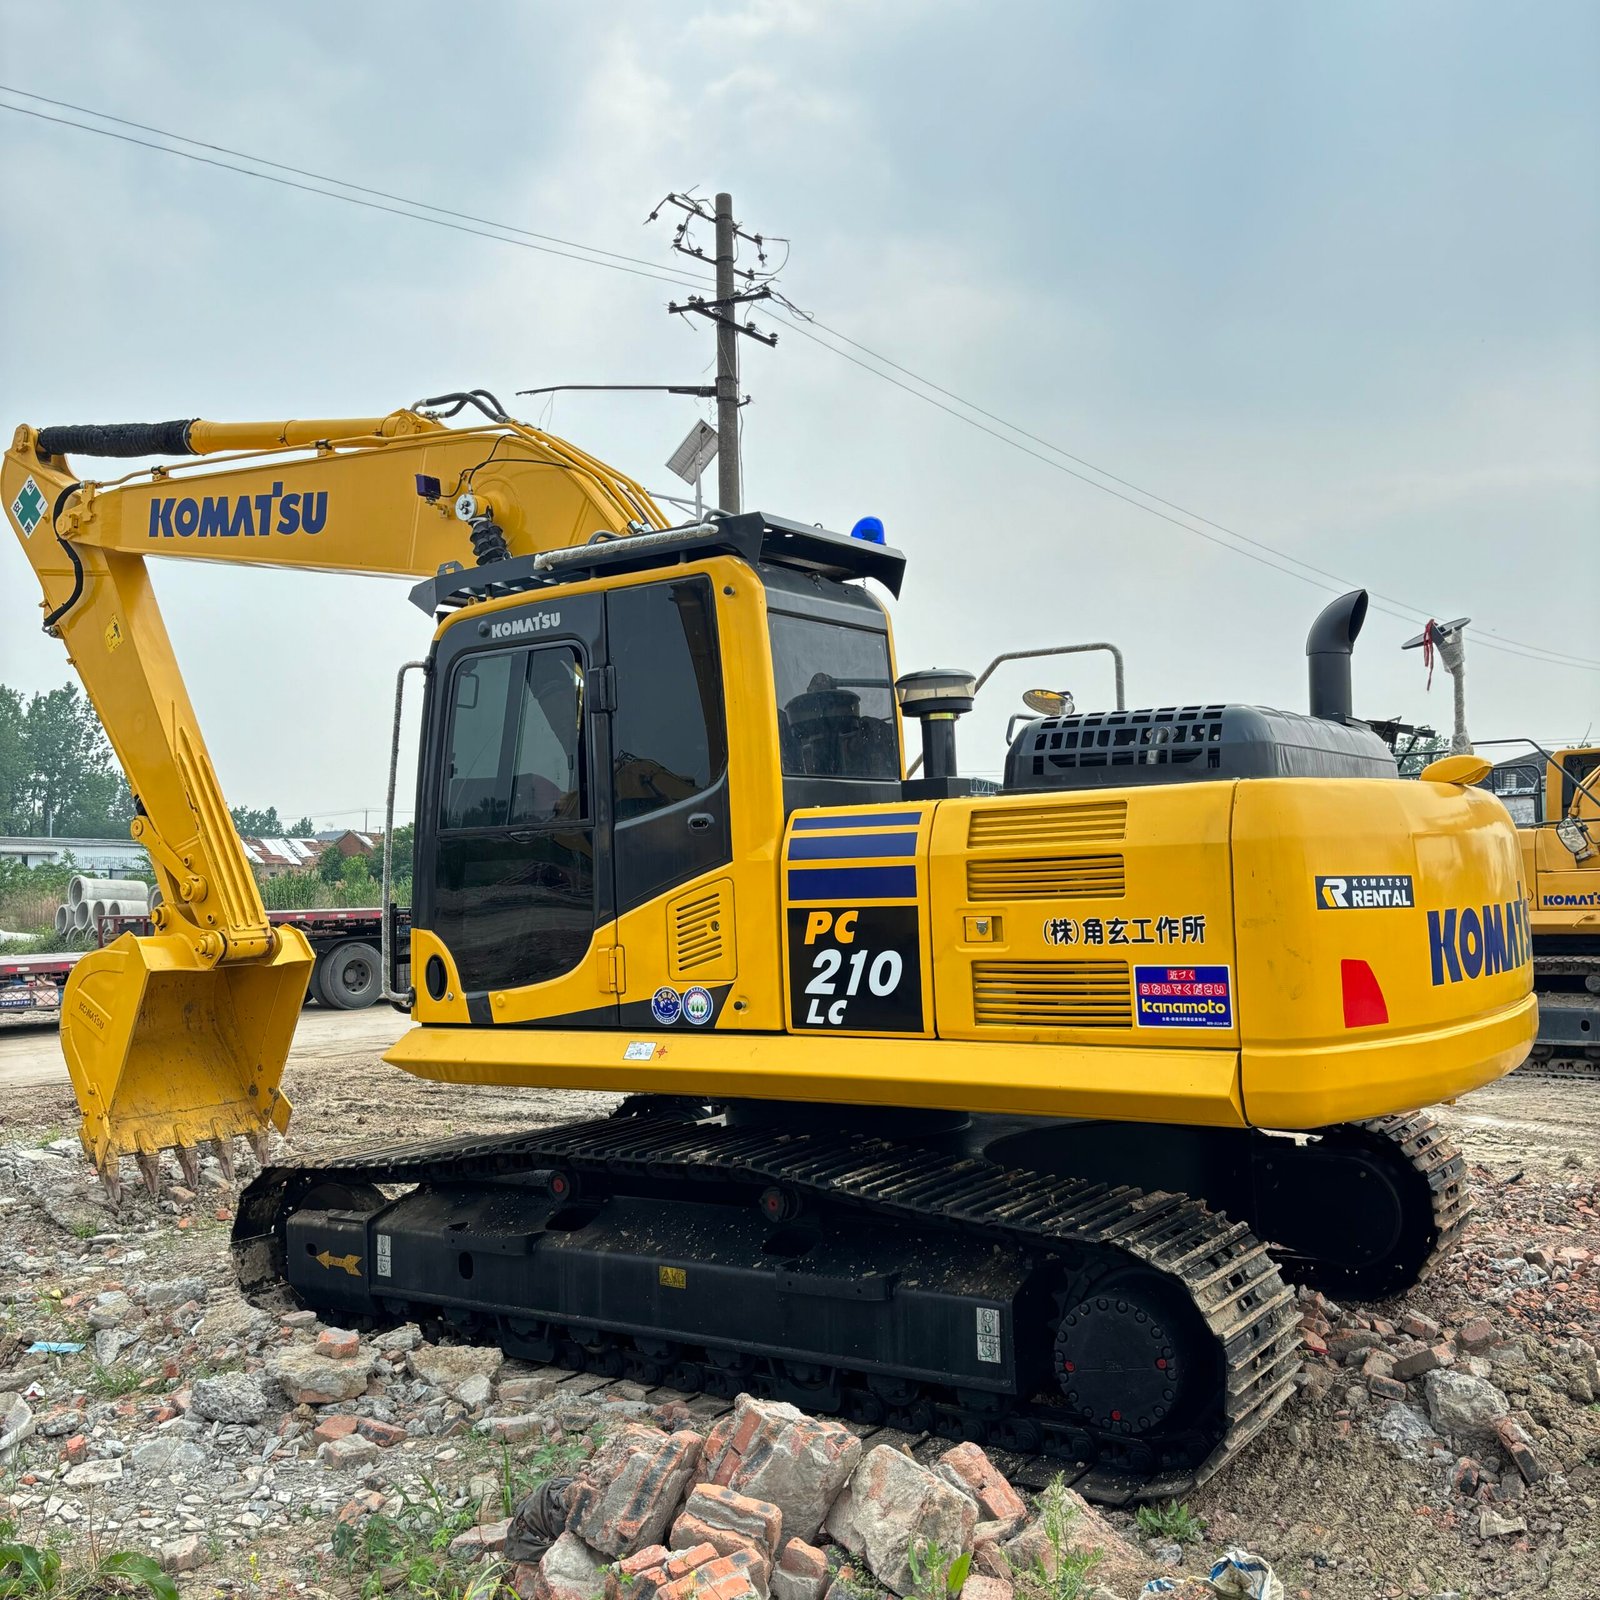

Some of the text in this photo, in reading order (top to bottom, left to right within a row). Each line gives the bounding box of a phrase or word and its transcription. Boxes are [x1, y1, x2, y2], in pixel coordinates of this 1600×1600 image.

[149, 481, 328, 537] KOMATSU
[491, 611, 561, 639] KOMATSU
[1352, 878, 1408, 887] KOMATSU
[1352, 889, 1411, 907] RENTAL
[804, 910, 859, 945] PC
[1043, 915, 1206, 945] (株)角玄工作所
[804, 948, 903, 997] 210
[806, 999, 848, 1025] LC
[1141, 998, 1226, 1014] kanamoto
